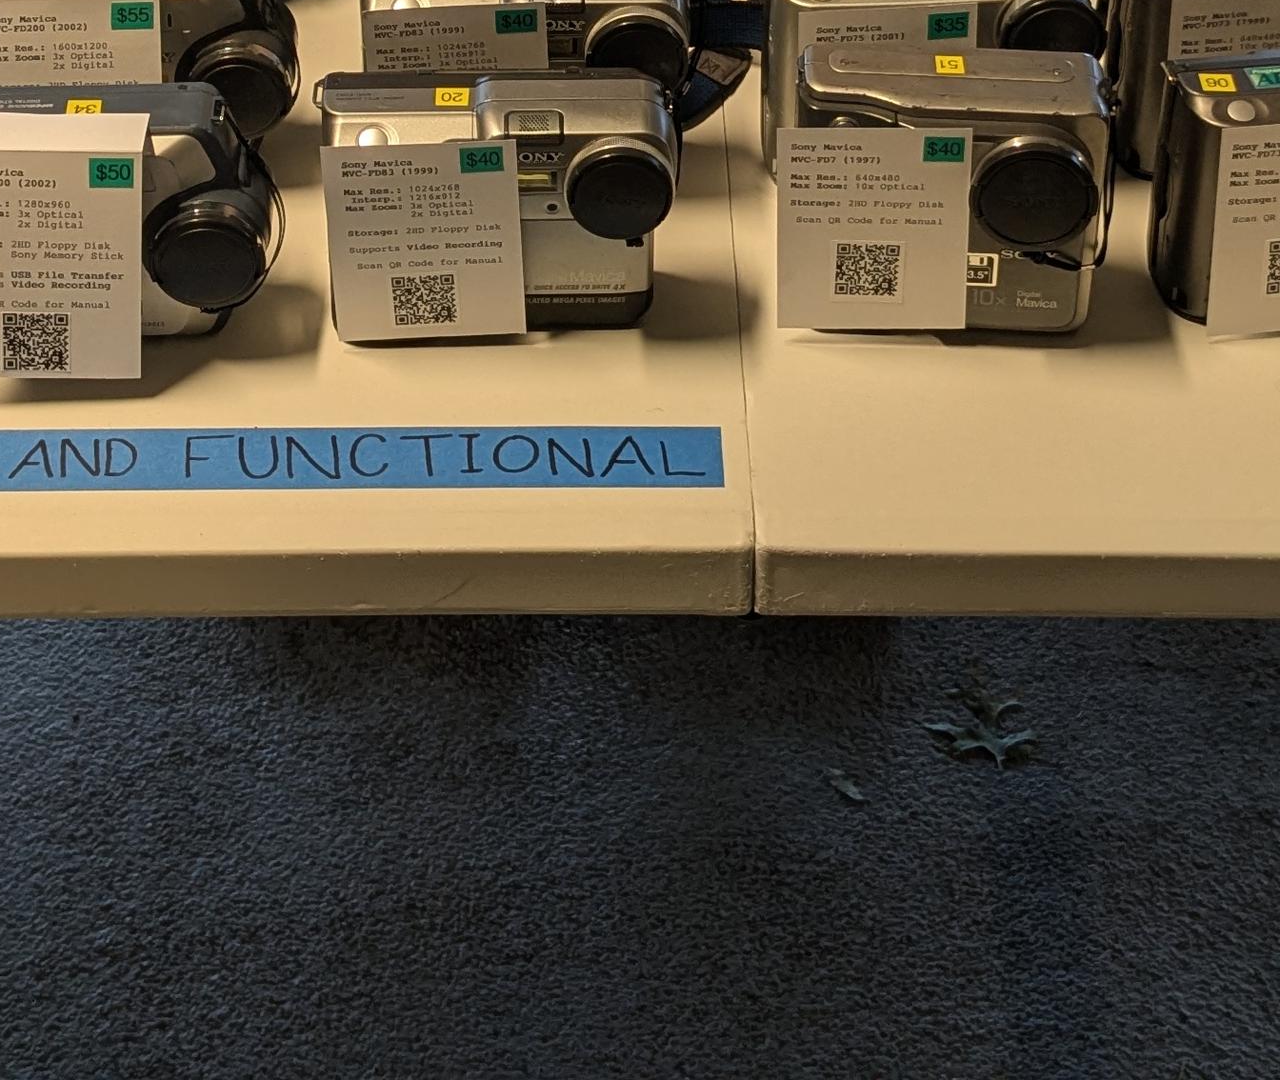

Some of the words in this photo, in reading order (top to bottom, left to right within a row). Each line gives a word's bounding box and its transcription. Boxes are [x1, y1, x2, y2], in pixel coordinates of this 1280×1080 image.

[116, 7, 149, 24] $55
[500, 13, 534, 28] $40
[933, 17, 965, 32] $35
[791, 144, 816, 152] Sony
[926, 141, 961, 157] $40
[465, 151, 501, 167] $40
[518, 151, 565, 164] ONY
[844, 156, 880, 164] (1997)
[95, 163, 131, 182] $50
[402, 167, 438, 176] (1999)
[19, 179, 56, 188] (2002)
[19, 200, 70, 209] 1280x960
[37, 210, 83, 220] Optical
[18, 220, 31, 228] 2x
[38, 220, 83, 230] Digital
[11, 240, 31, 248] 2HD
[38, 241, 77, 251] Floppy
[85, 242, 111, 251] Disk
[11, 251, 37, 260] Sony
[43, 251, 84, 261] Memory
[91, 252, 123, 260] Stick
[11, 271, 32, 279] USB
[38, 271, 64, 279] File
[71, 272, 124, 280] Transfer
[11, 280, 45, 288] Video
[51, 281, 111, 291] Recording
[11, 300, 37, 312] Code
[45, 300, 64, 308] for
[1015, 297, 1057, 310] Mavica
[7, 433, 138, 480] AND
[183, 432, 707, 480] FUNCTIONAL
